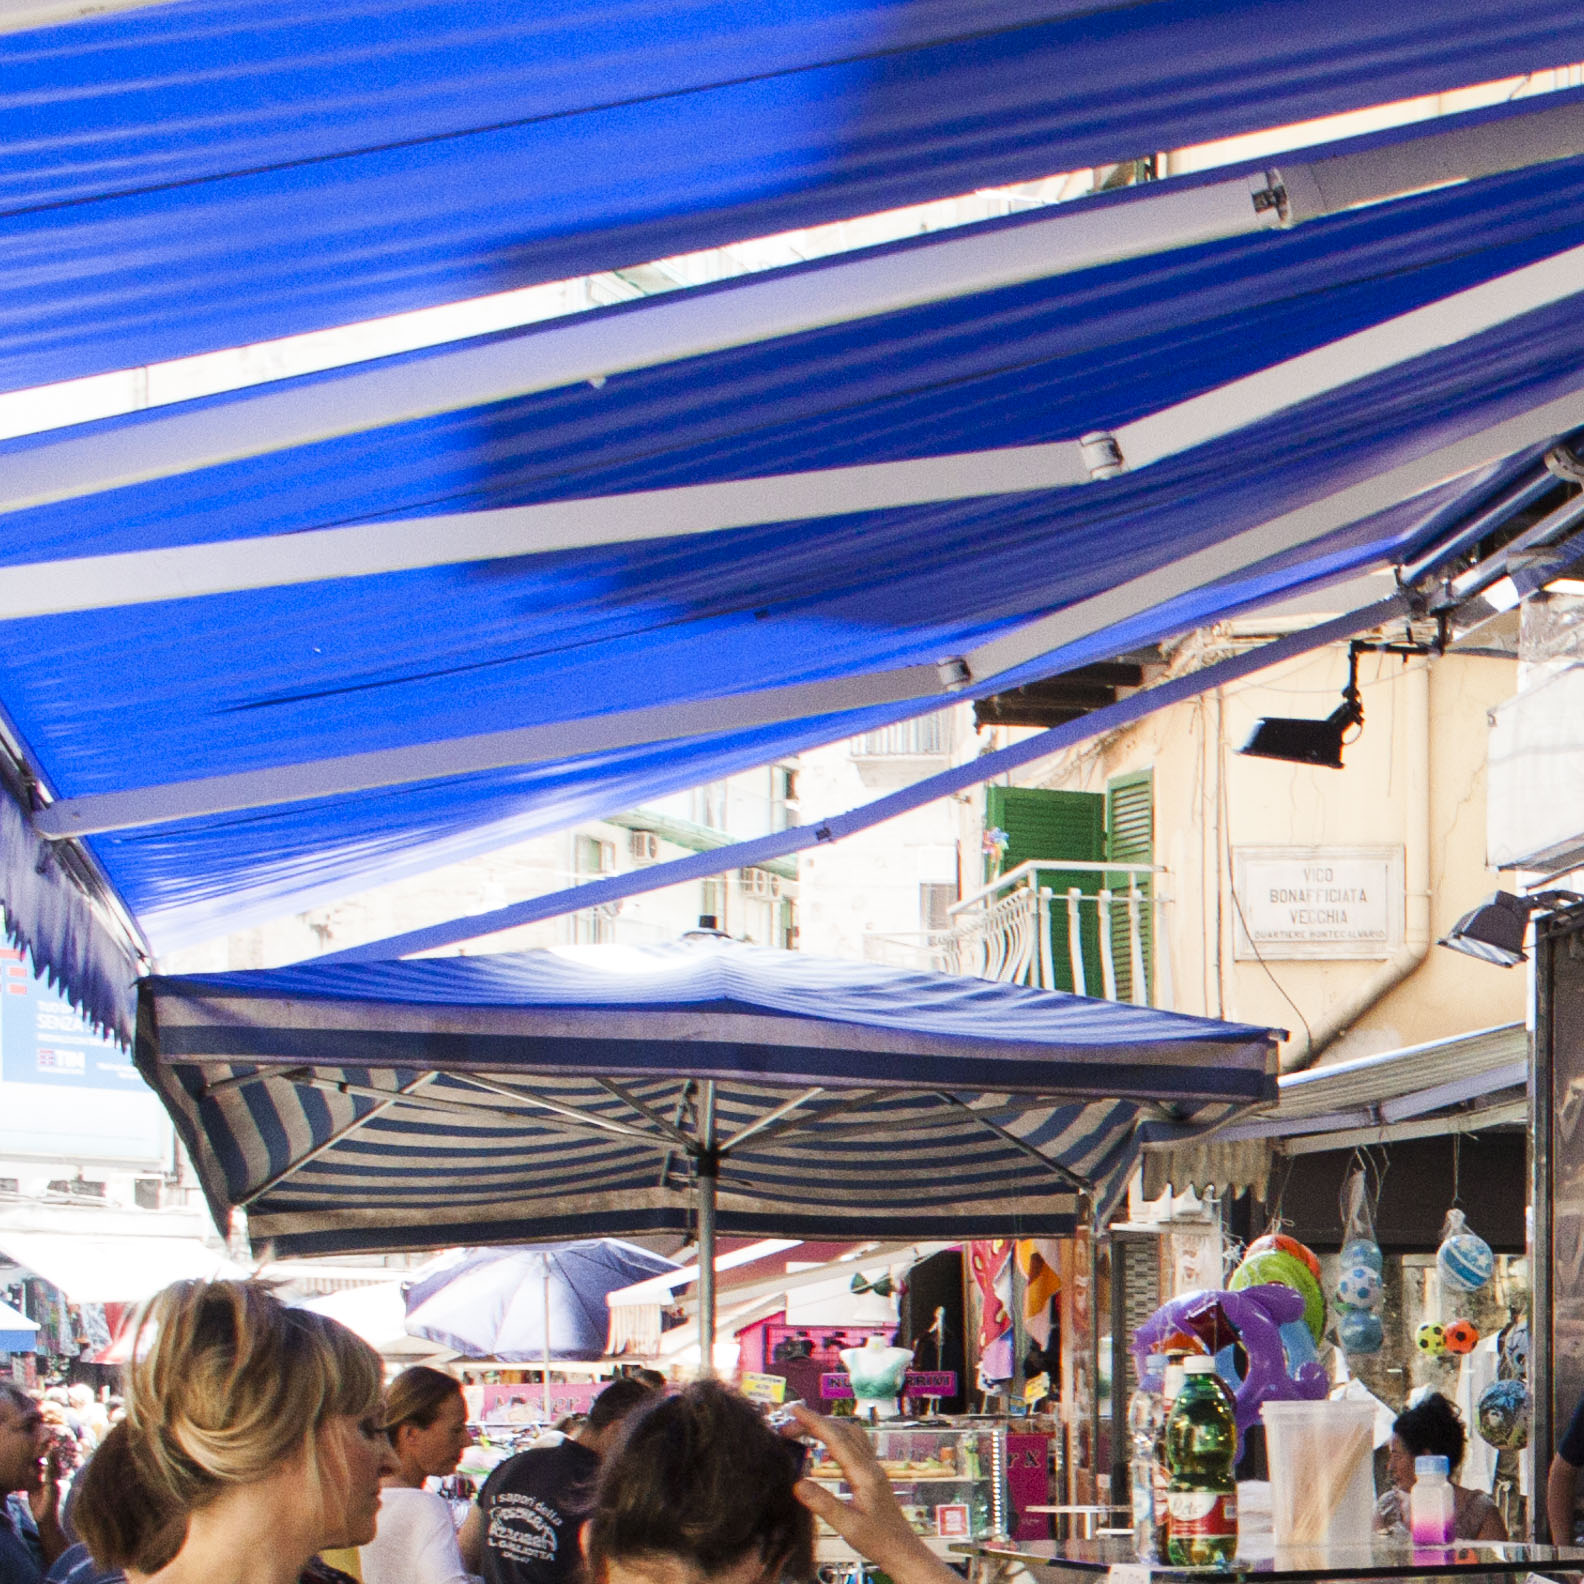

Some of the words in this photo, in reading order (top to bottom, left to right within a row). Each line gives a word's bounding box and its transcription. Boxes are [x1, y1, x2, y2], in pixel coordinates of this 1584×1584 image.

[1303, 868, 1334, 882] VICO
[1269, 888, 1368, 903] BONAFFICIATA
[1289, 909, 1348, 924] VECCHIA
